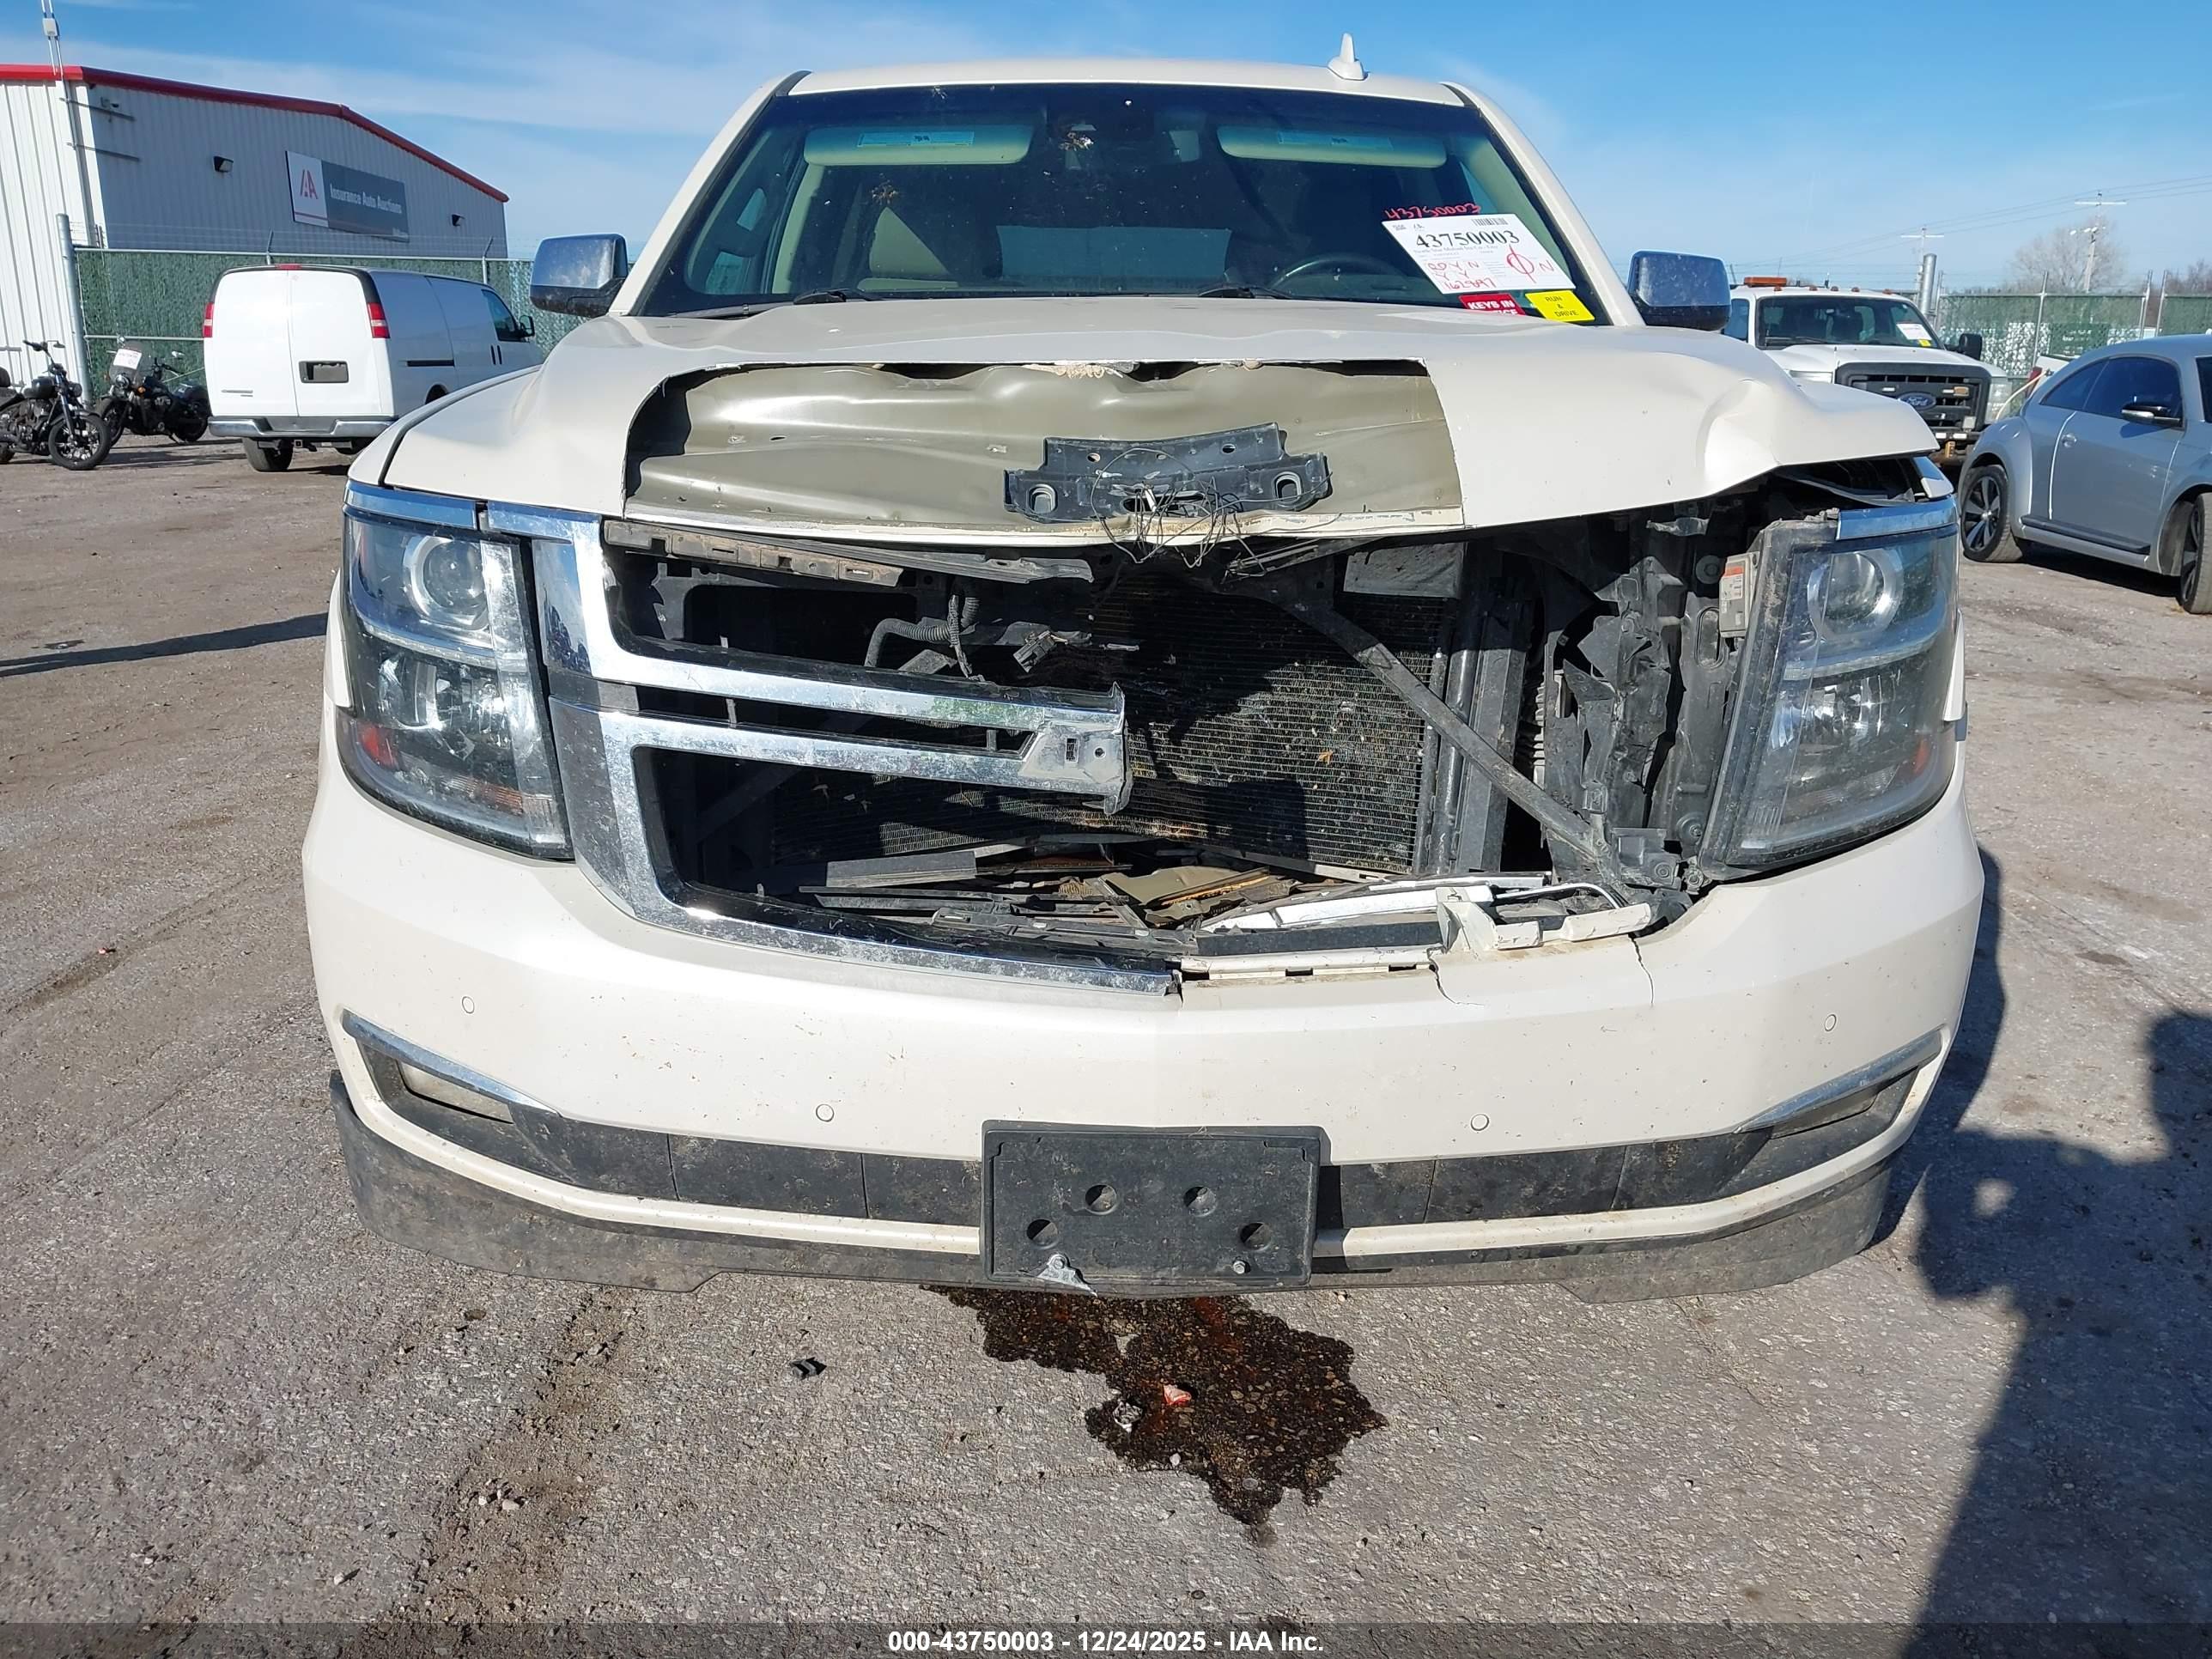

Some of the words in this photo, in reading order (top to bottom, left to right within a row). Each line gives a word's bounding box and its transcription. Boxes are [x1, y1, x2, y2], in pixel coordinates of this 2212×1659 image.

[1384, 203, 1481, 219] 43750003
[1417, 230, 1520, 248] 43750003
[1467, 301, 1500, 310] KEYS
[1500, 299, 1516, 308] IN
[1905, 396, 1929, 406] Ford
